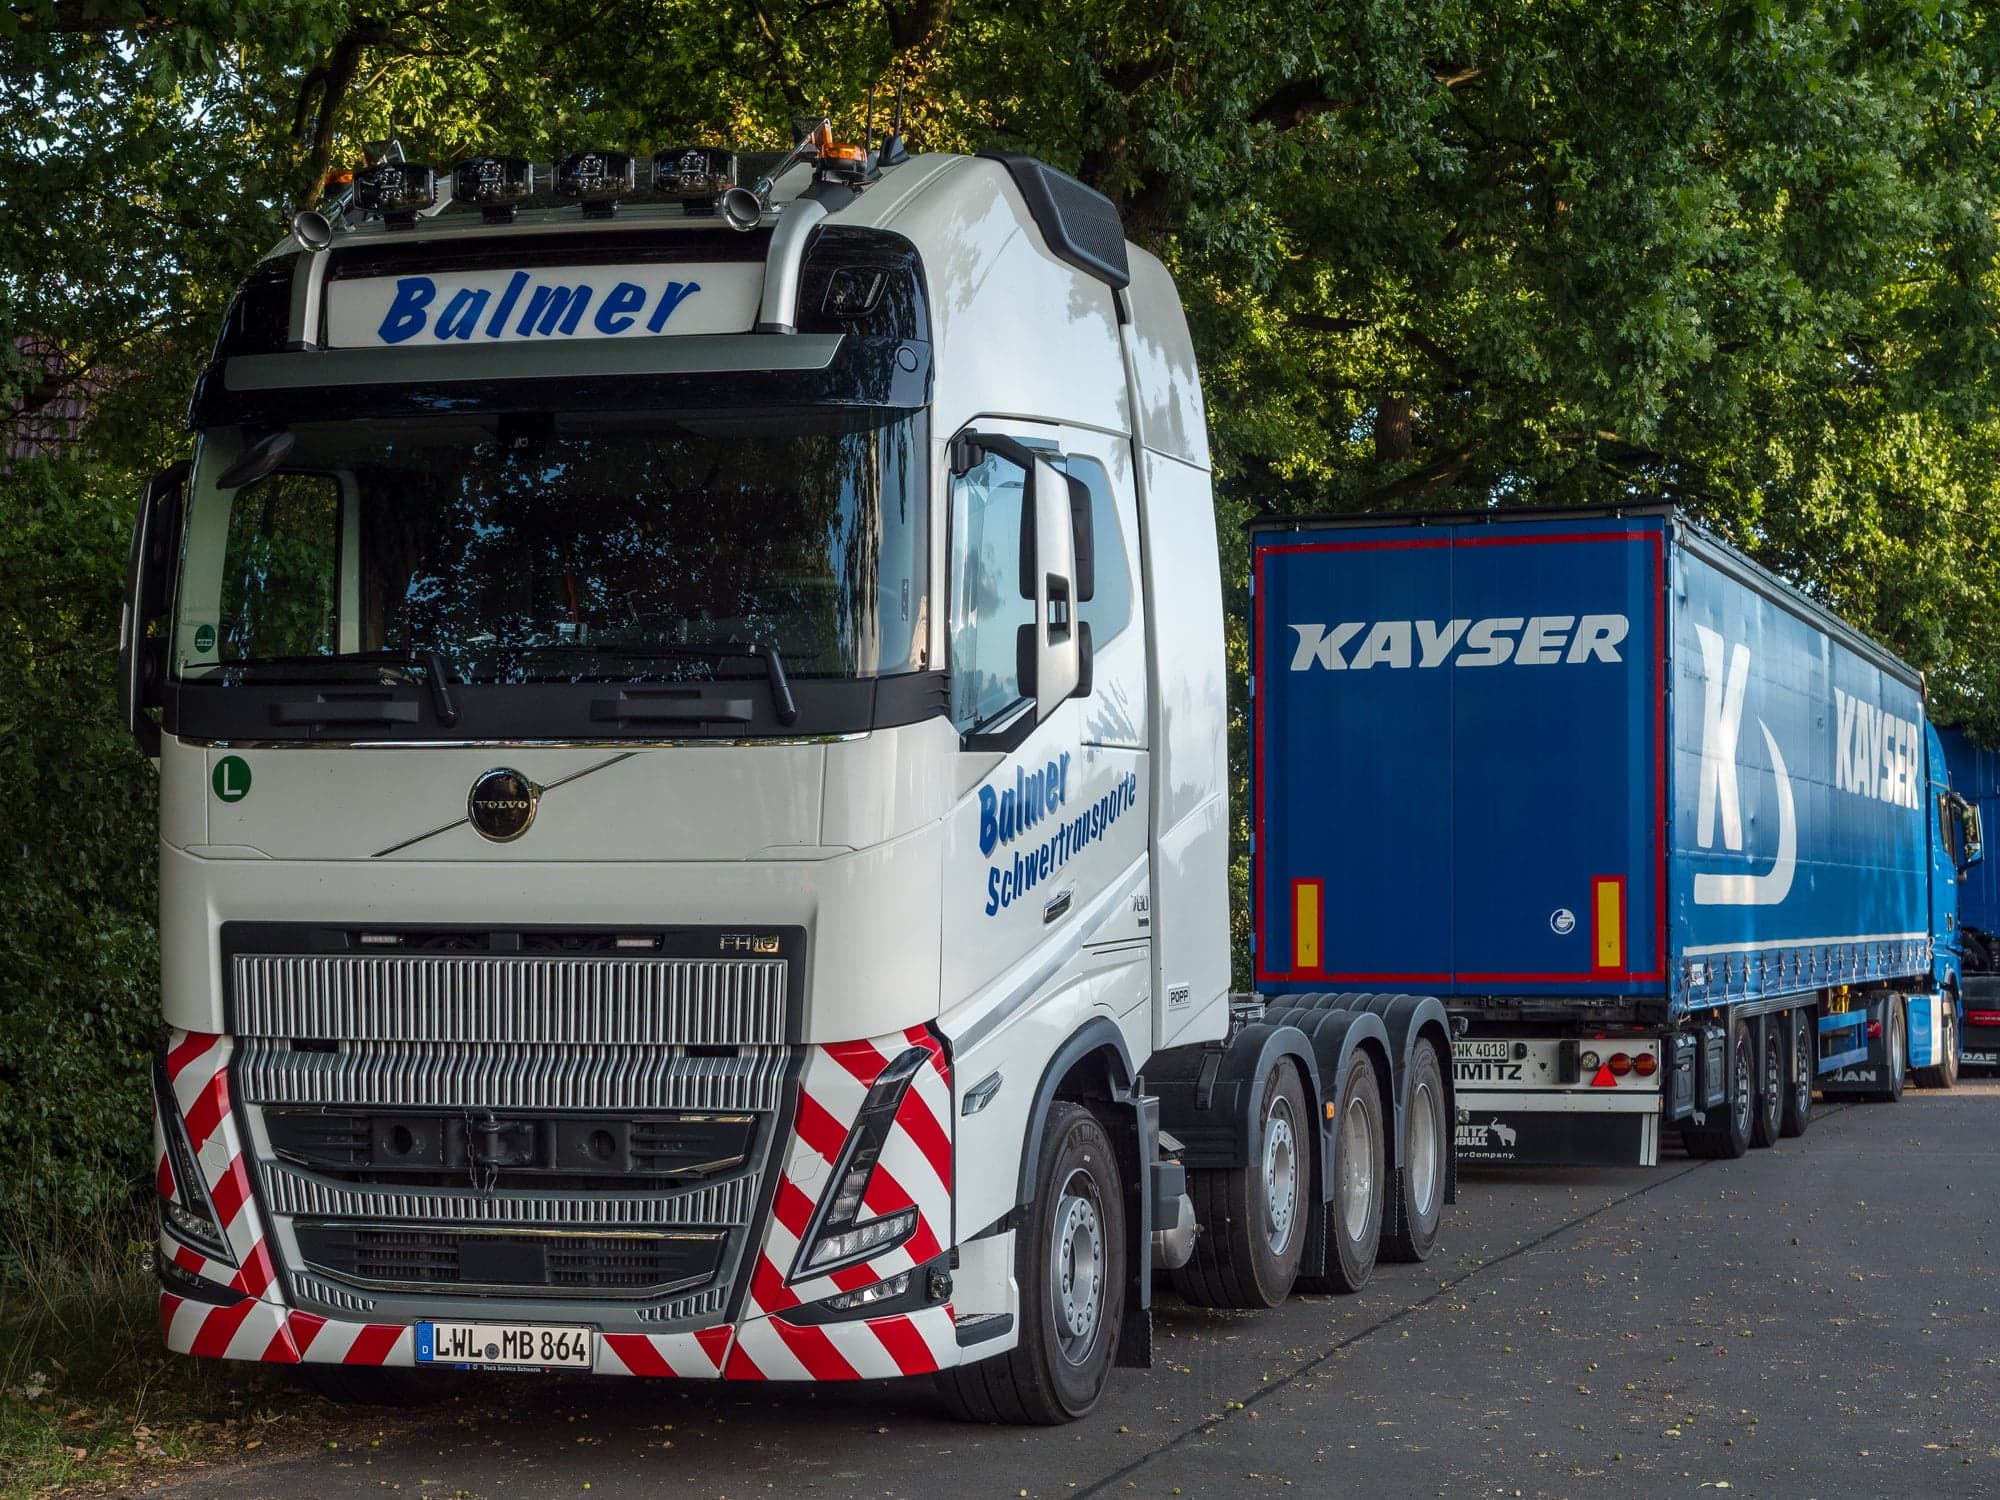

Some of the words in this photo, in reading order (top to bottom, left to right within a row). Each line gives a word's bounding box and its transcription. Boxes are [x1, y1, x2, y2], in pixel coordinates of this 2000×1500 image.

[378, 271, 701, 344] Balmer
[1287, 614, 1630, 672] KAYSER
[1833, 686, 1919, 811] KAYSER
[222, 764, 242, 796] L
[475, 800, 529, 809] VOLVO
[978, 751, 1070, 858] Balmer
[985, 771, 1137, 917] Schwertransporte
[1170, 989, 1189, 1004] POPP
[1457, 1043, 1473, 1057] WK
[1475, 1043, 1506, 1057] 4018
[1960, 1052, 1998, 1062] DAF
[1469, 1151, 1516, 1159] Company.
[422, 1346, 429, 1354] D
[435, 1327, 483, 1358] LWL
[502, 1330, 534, 1360] MB
[540, 1331, 586, 1362] 864
